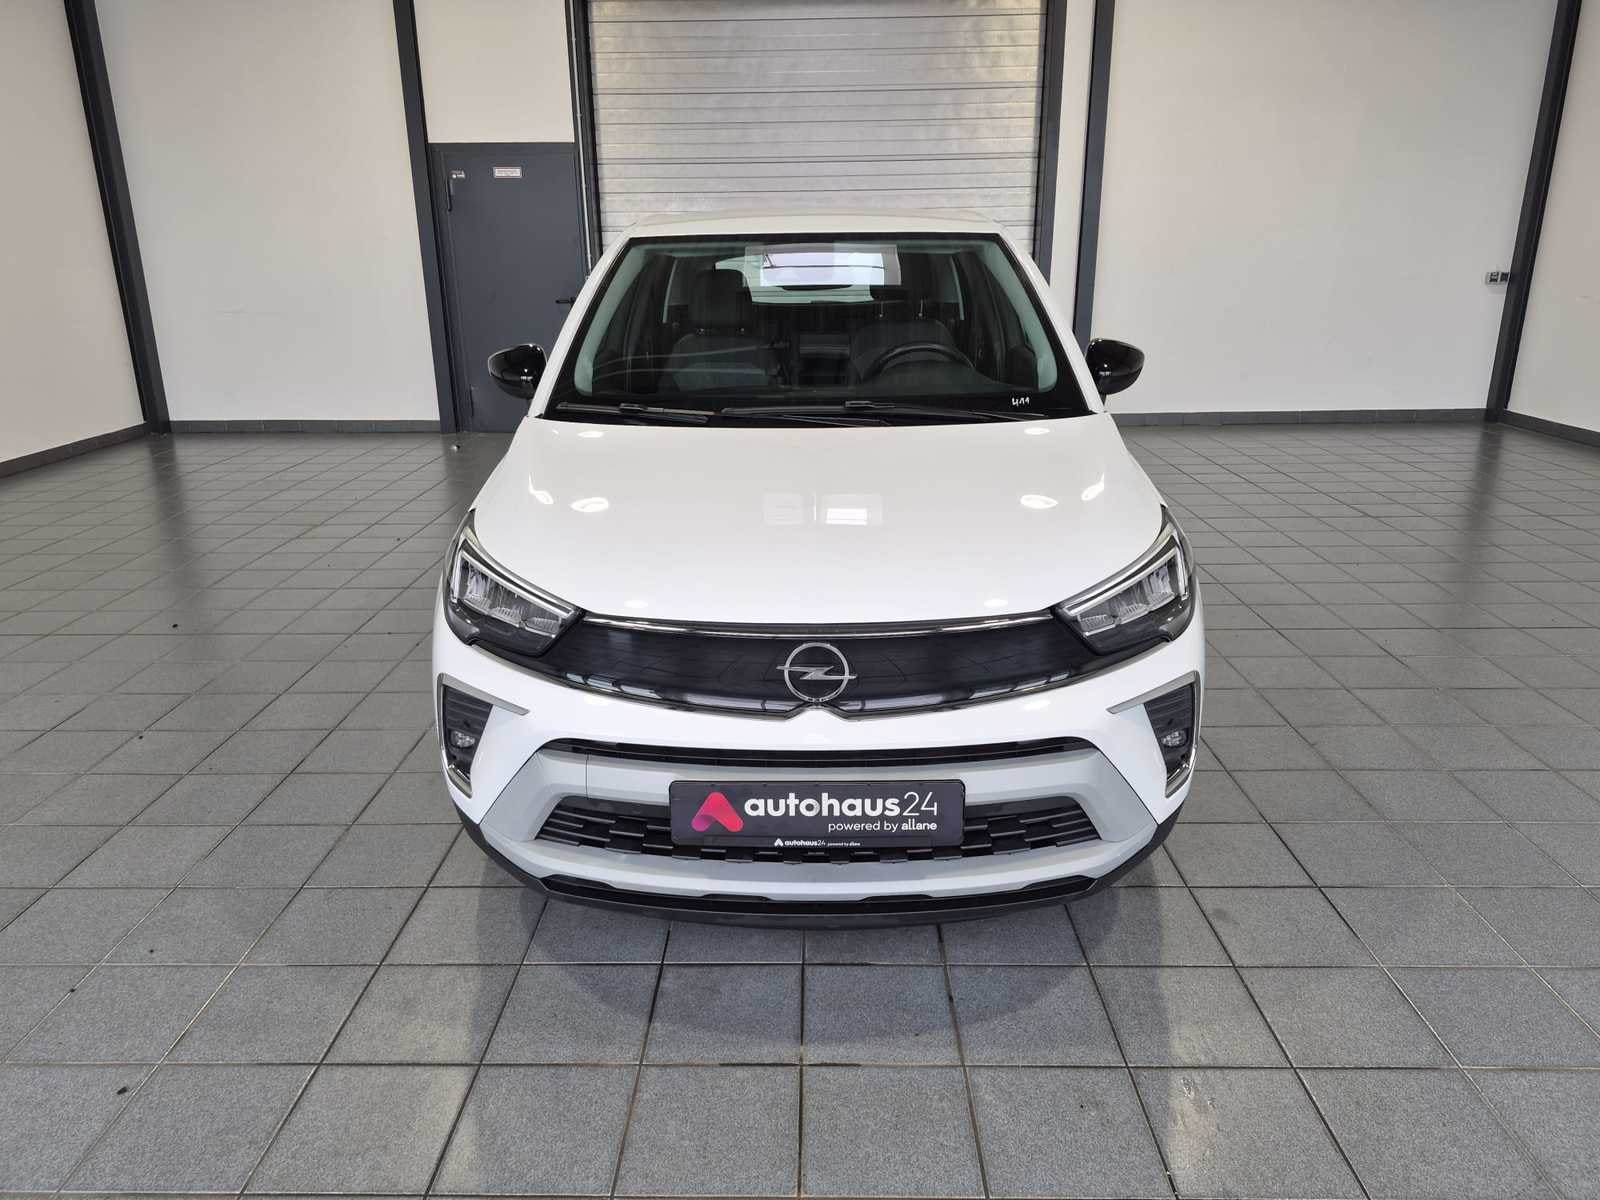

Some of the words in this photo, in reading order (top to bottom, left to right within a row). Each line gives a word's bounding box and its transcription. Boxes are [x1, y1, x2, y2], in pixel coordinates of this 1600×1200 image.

[744, 791, 938, 817] autohaus24
[828, 820, 881, 832] powered
[883, 820, 899, 832] by
[901, 818, 938, 831] allane
[784, 839, 826, 847] autohaus24
